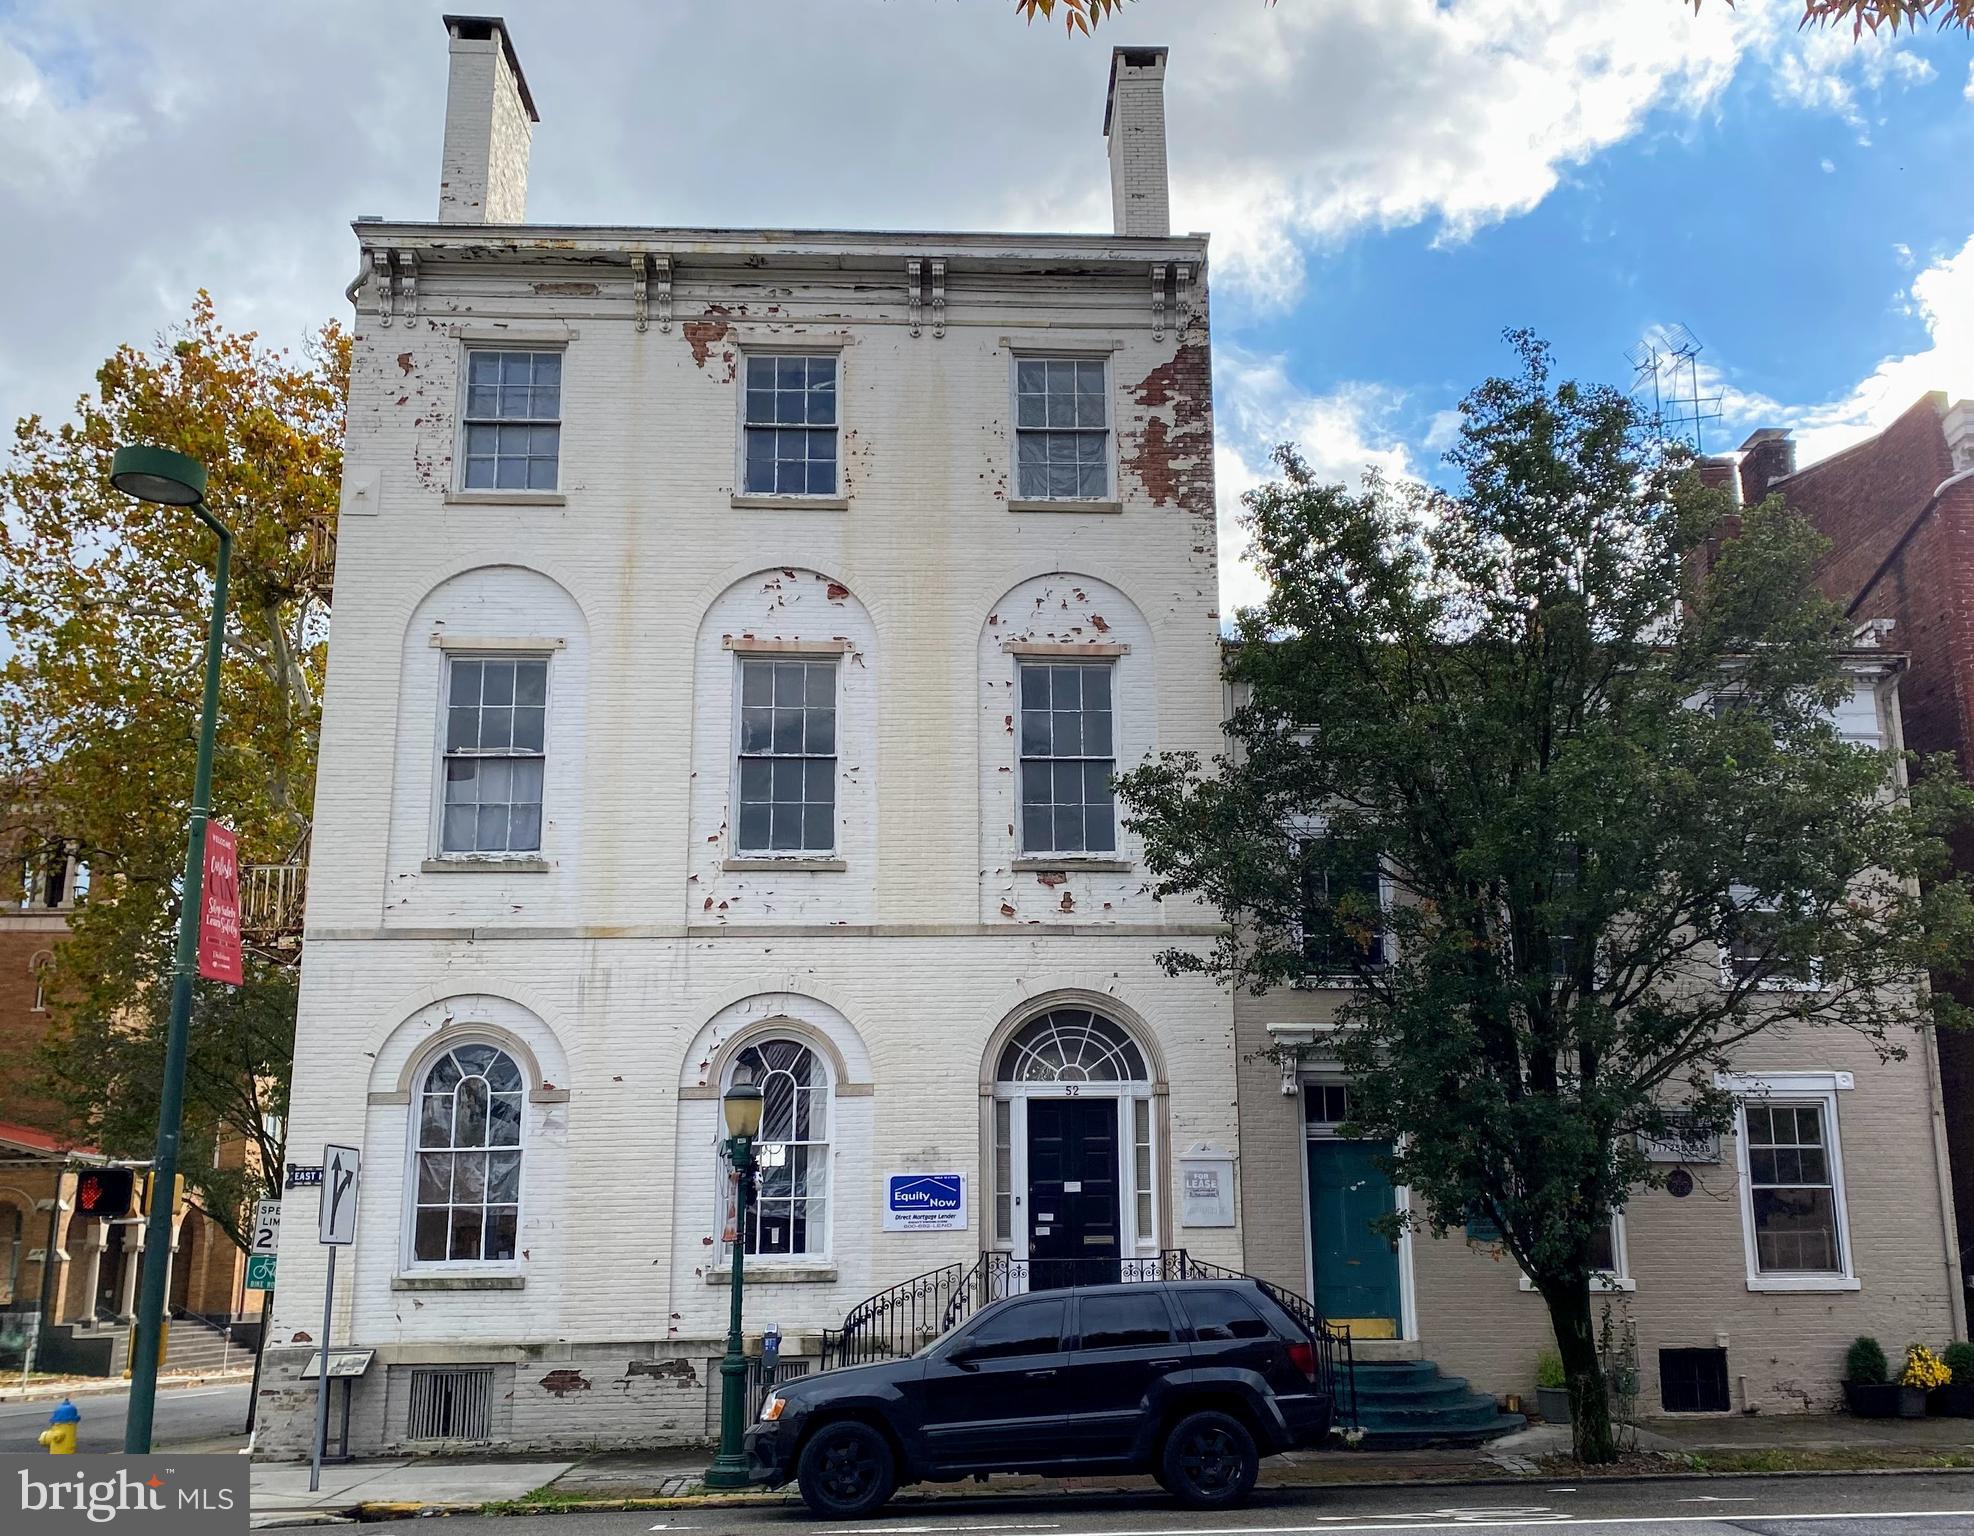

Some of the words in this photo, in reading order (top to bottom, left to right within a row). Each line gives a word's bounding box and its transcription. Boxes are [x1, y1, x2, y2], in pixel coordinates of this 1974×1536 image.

[1065, 1085, 1080, 1096] 52
[294, 1171, 316, 1181] EAST
[1186, 1179, 1217, 1189] LEASE
[894, 1191, 930, 1202] Equity
[929, 1198, 956, 1207] Now
